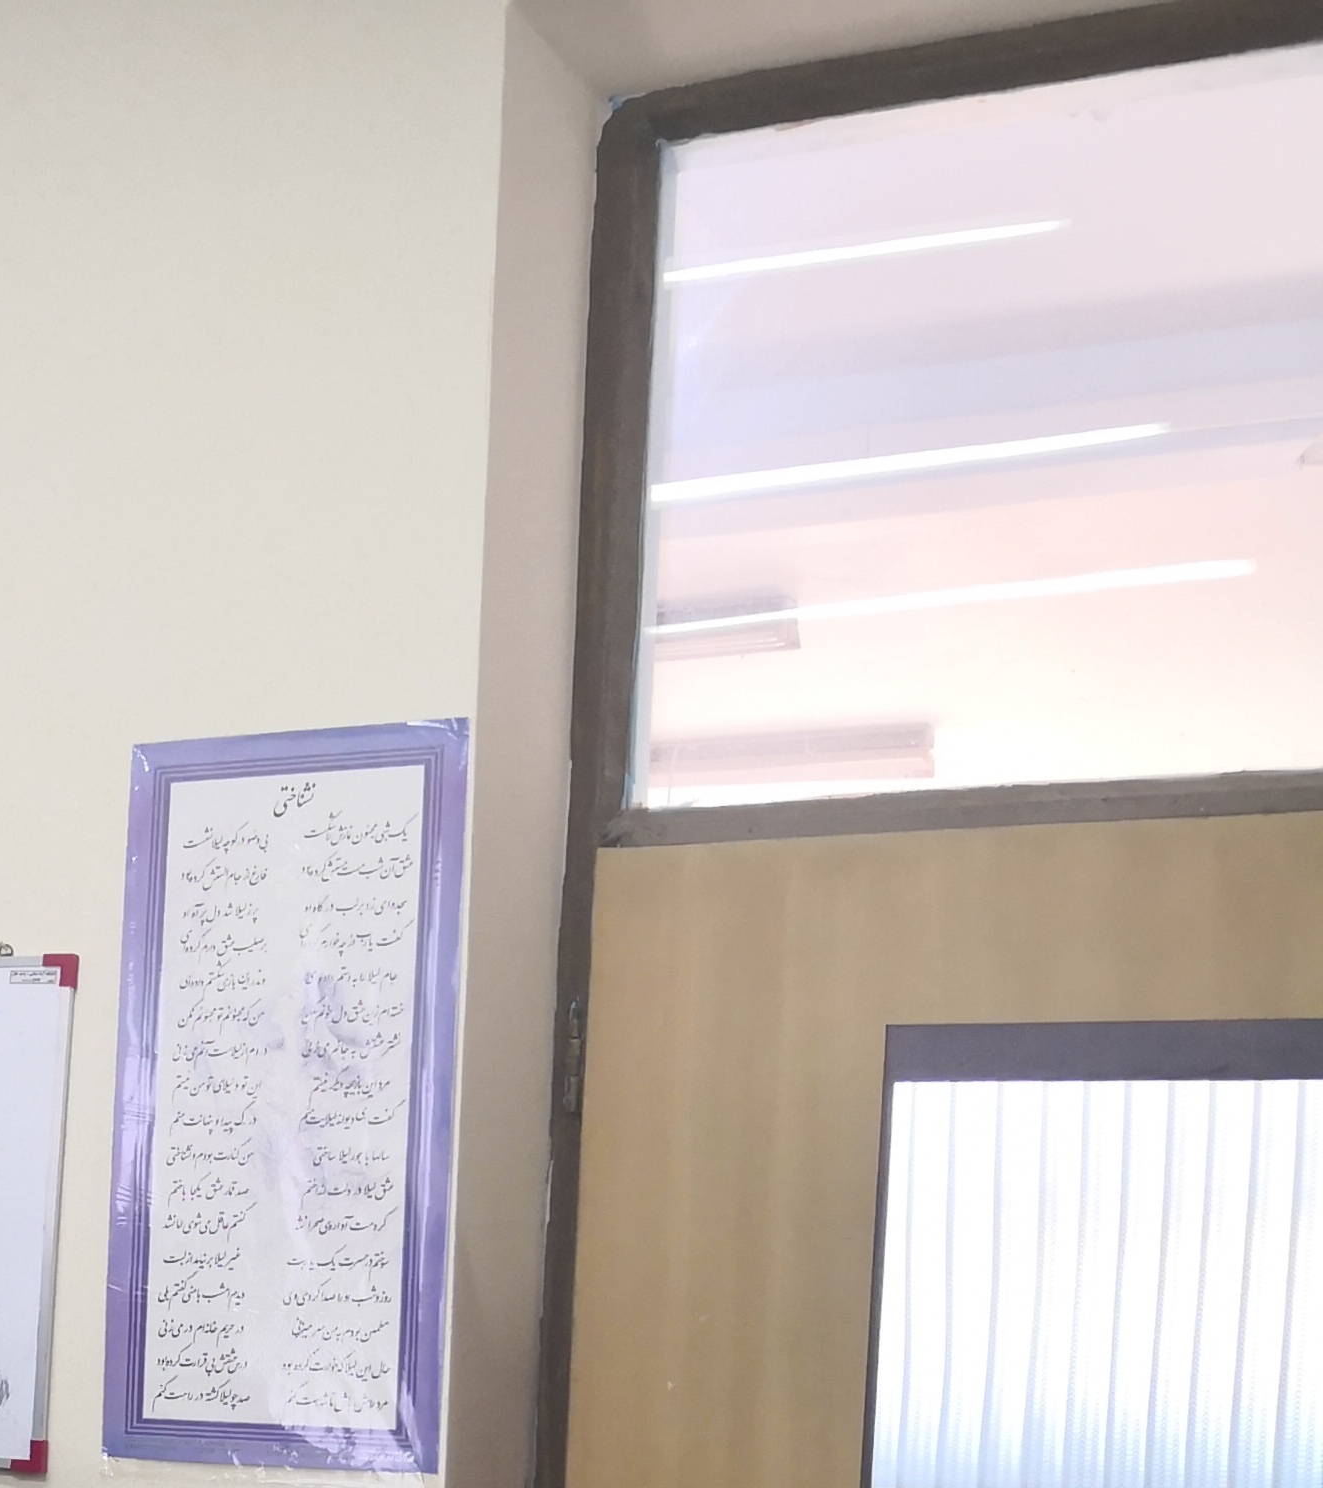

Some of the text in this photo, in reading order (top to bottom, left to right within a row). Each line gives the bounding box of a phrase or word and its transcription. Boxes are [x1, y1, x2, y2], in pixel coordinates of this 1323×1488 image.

[272, 782, 316, 817] نشناختی
[205, 1177, 223, 1200] عشق
[220, 1389, 231, 1405] لیلا
